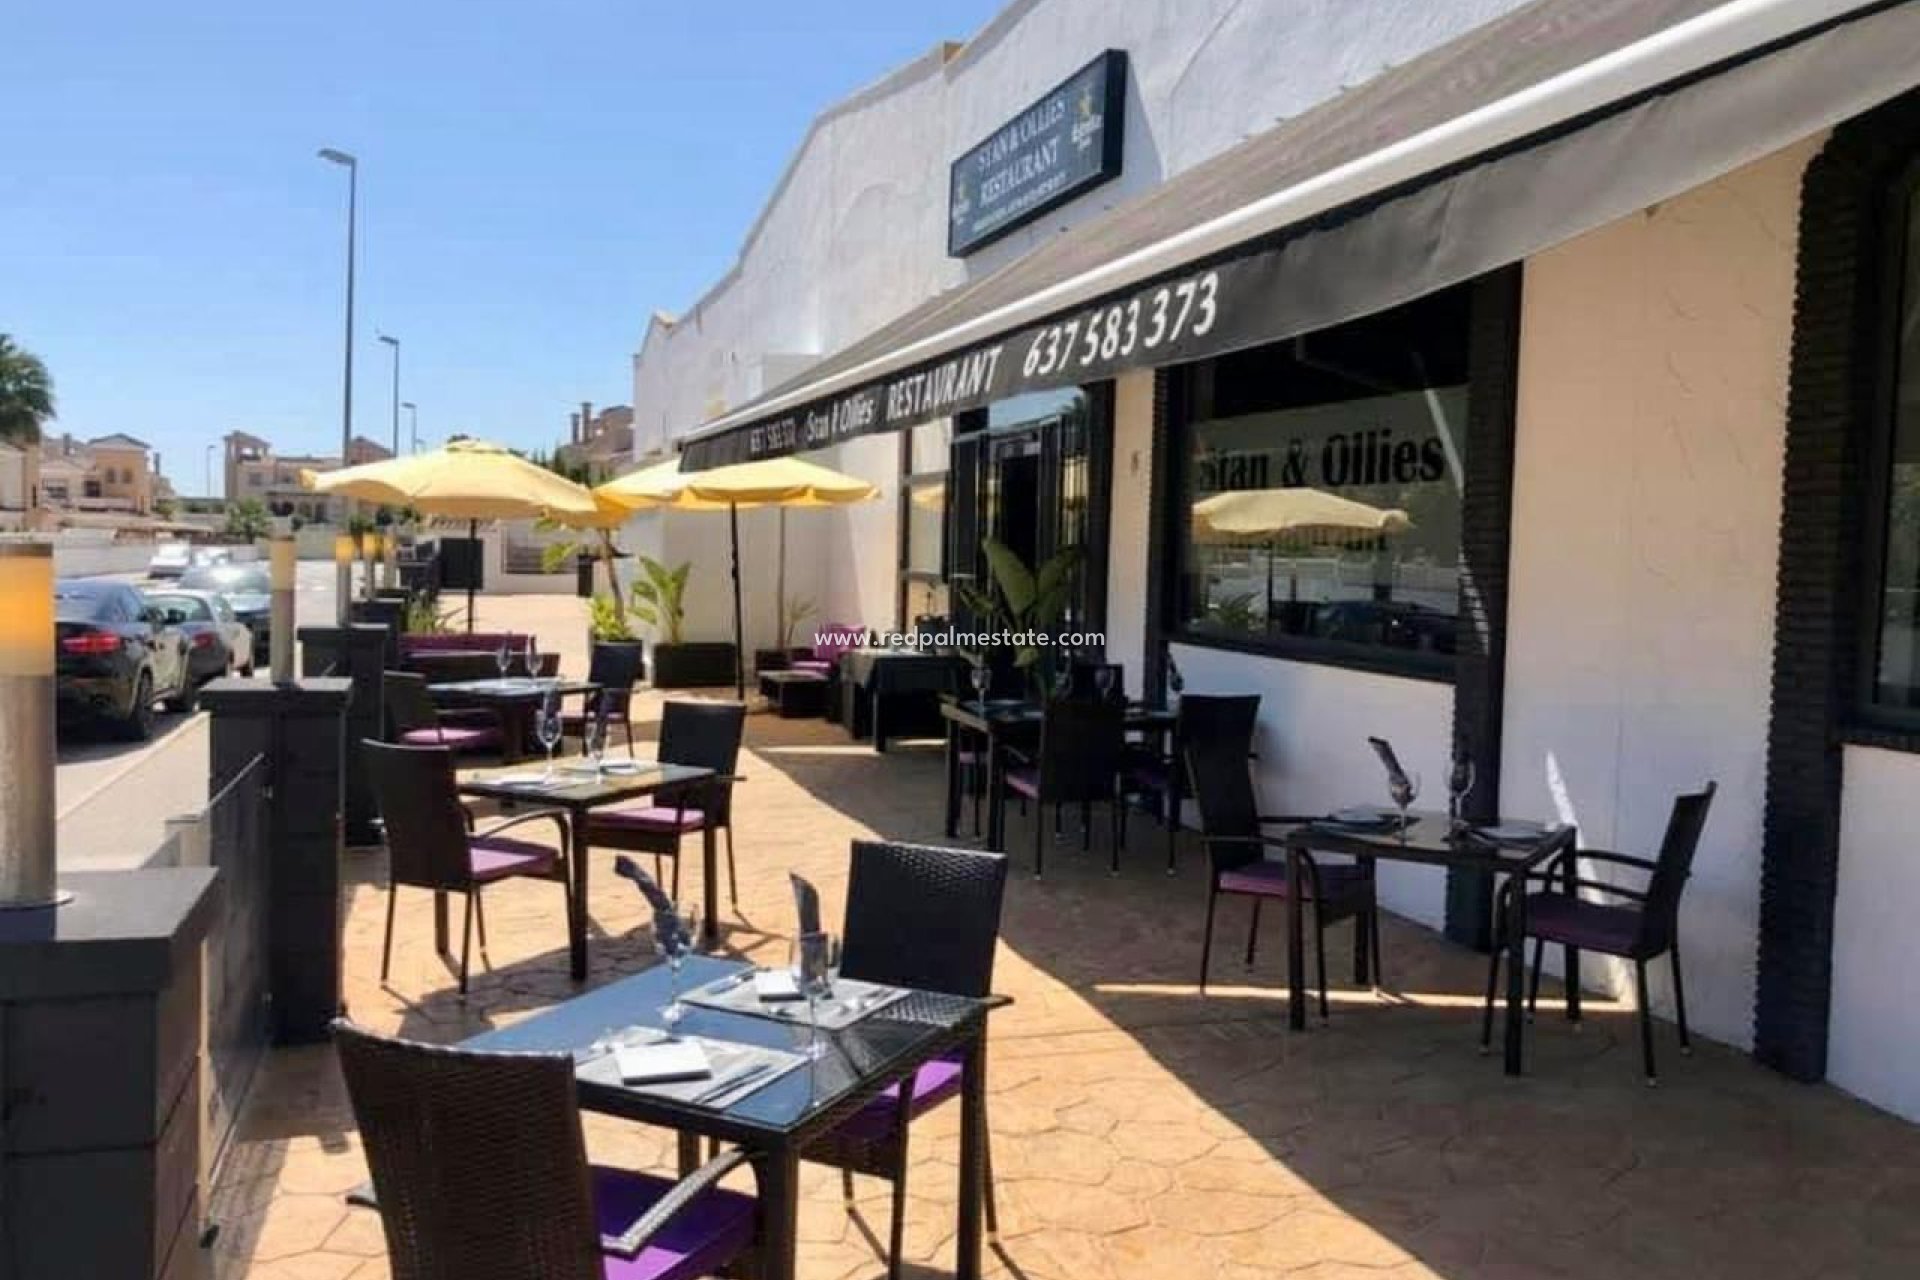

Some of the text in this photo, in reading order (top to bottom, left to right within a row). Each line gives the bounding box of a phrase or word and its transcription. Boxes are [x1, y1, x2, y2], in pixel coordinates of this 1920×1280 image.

[979, 136, 1058, 209] RESTAURANT
[887, 345, 1004, 422] RESTAURANT
[1022, 321, 1078, 377] 637
[1080, 299, 1141, 365] 583
[1144, 271, 1219, 347] 373
[1282, 438, 1309, 487] &
[1321, 427, 1445, 487] Ollies
